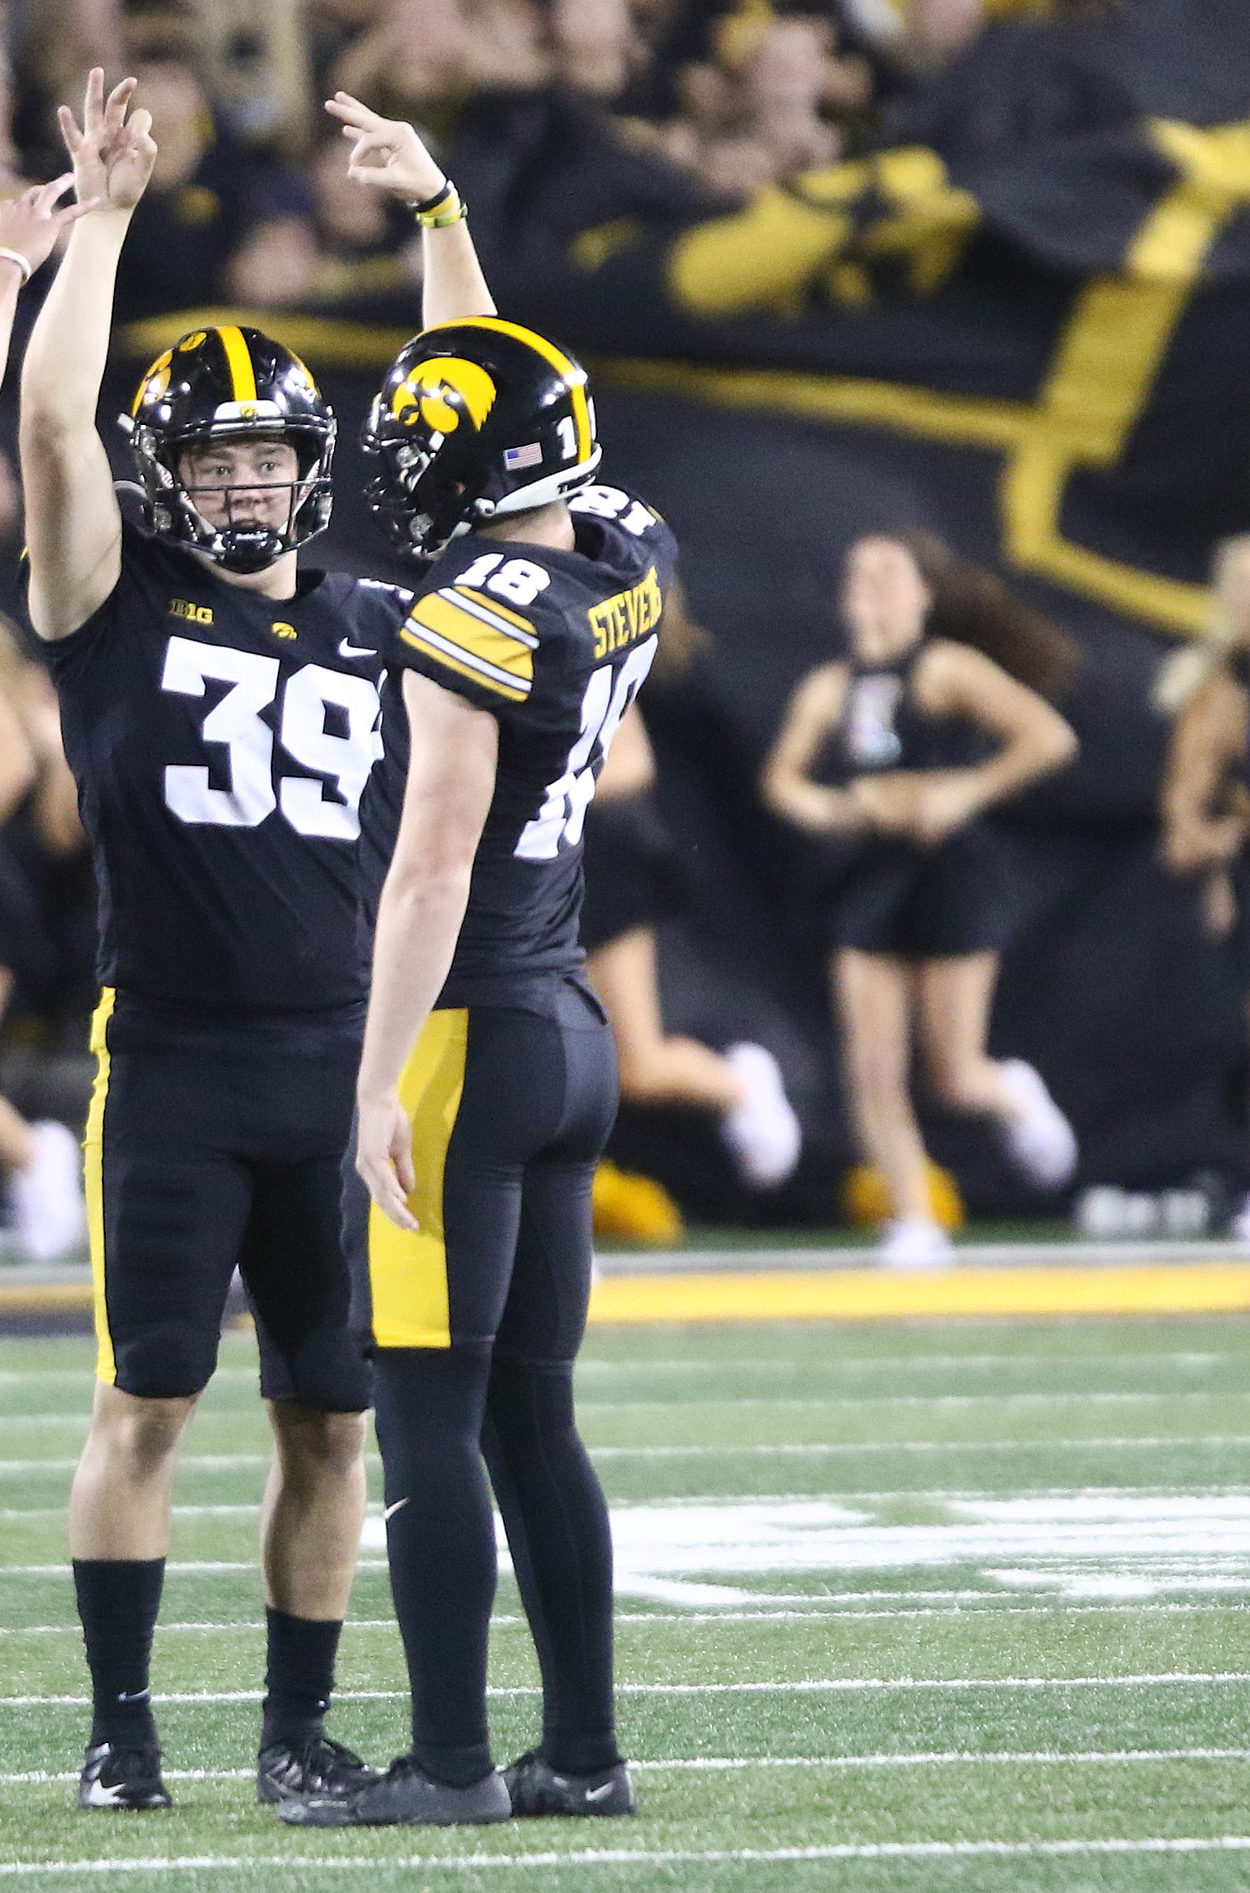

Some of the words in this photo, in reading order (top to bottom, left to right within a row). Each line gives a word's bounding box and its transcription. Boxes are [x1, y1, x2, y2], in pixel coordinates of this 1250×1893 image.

[453, 552, 552, 607] 18
[588, 565, 662, 659] STEVE
[161, 635, 385, 841] 39
